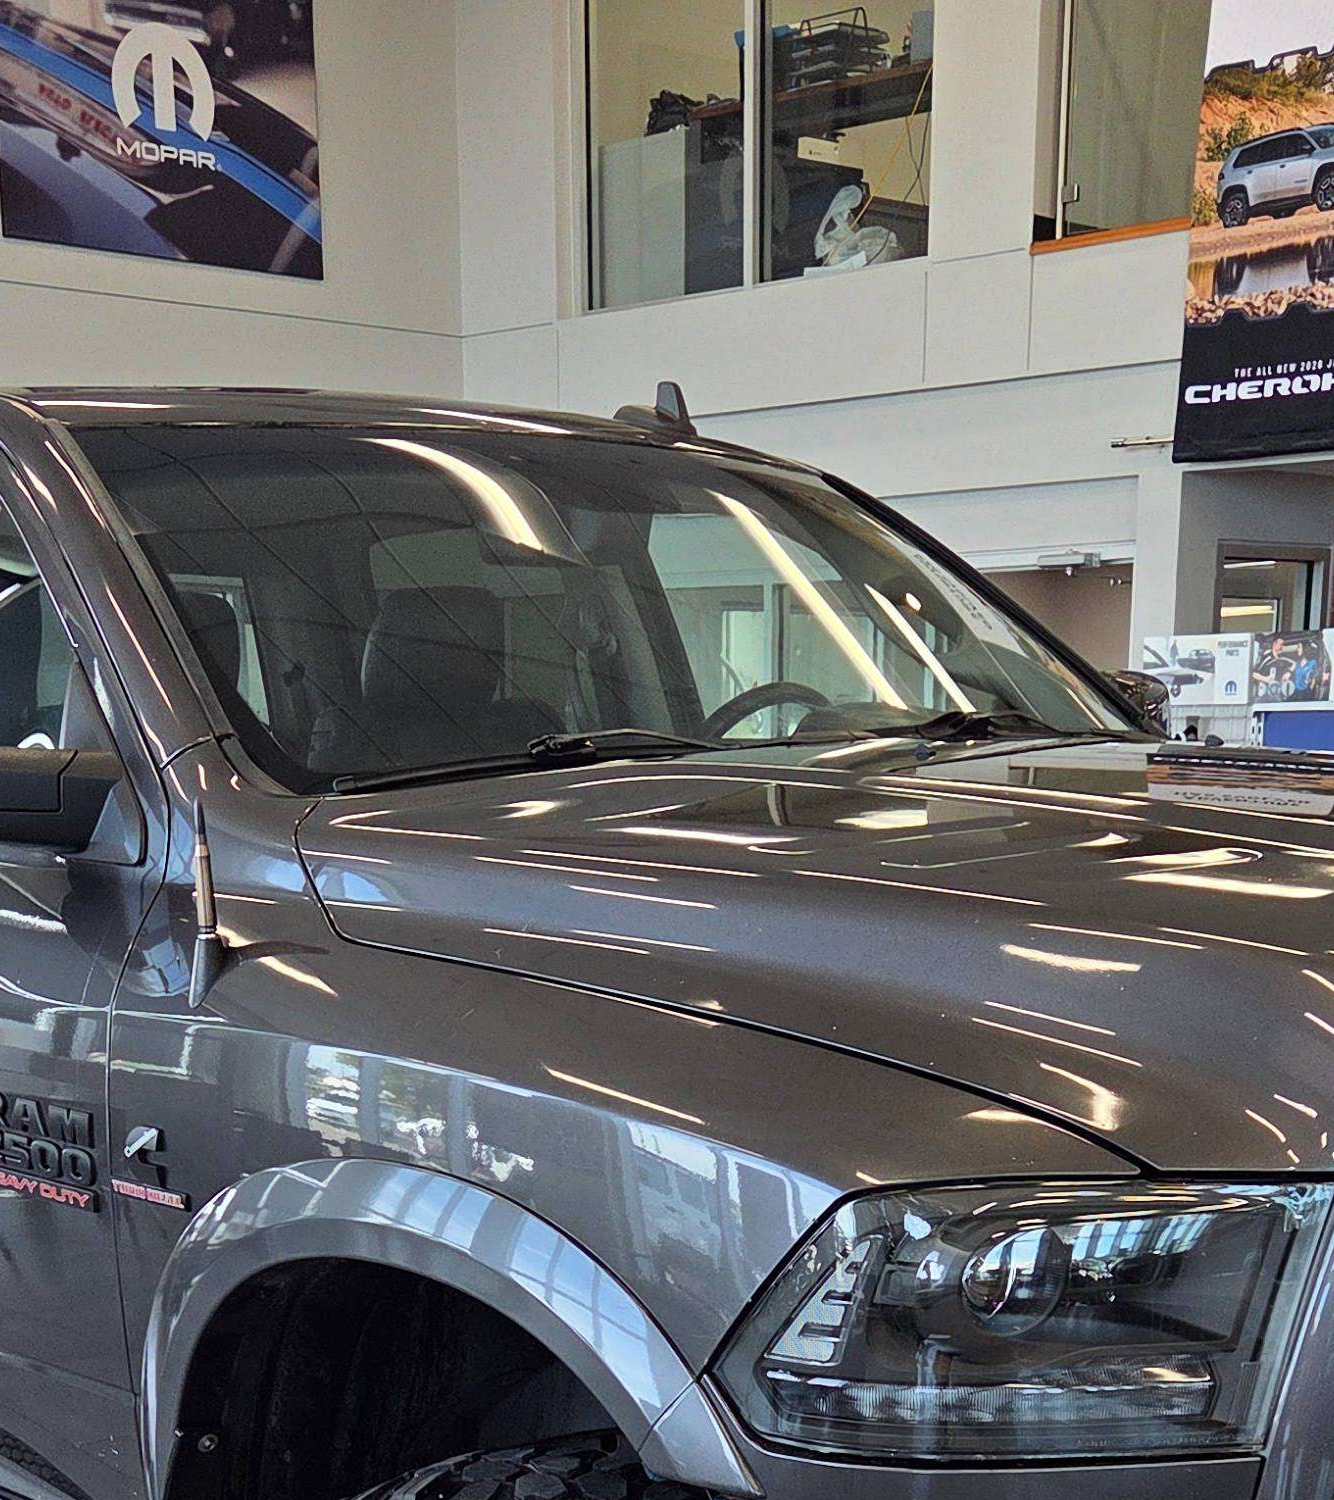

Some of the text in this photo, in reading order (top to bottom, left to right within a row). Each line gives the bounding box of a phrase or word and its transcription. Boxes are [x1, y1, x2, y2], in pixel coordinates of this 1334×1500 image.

[116, 137, 217, 170] MOPAR
[1256, 365, 1272, 377] ALL
[40, 1182, 91, 1208] DUTY
